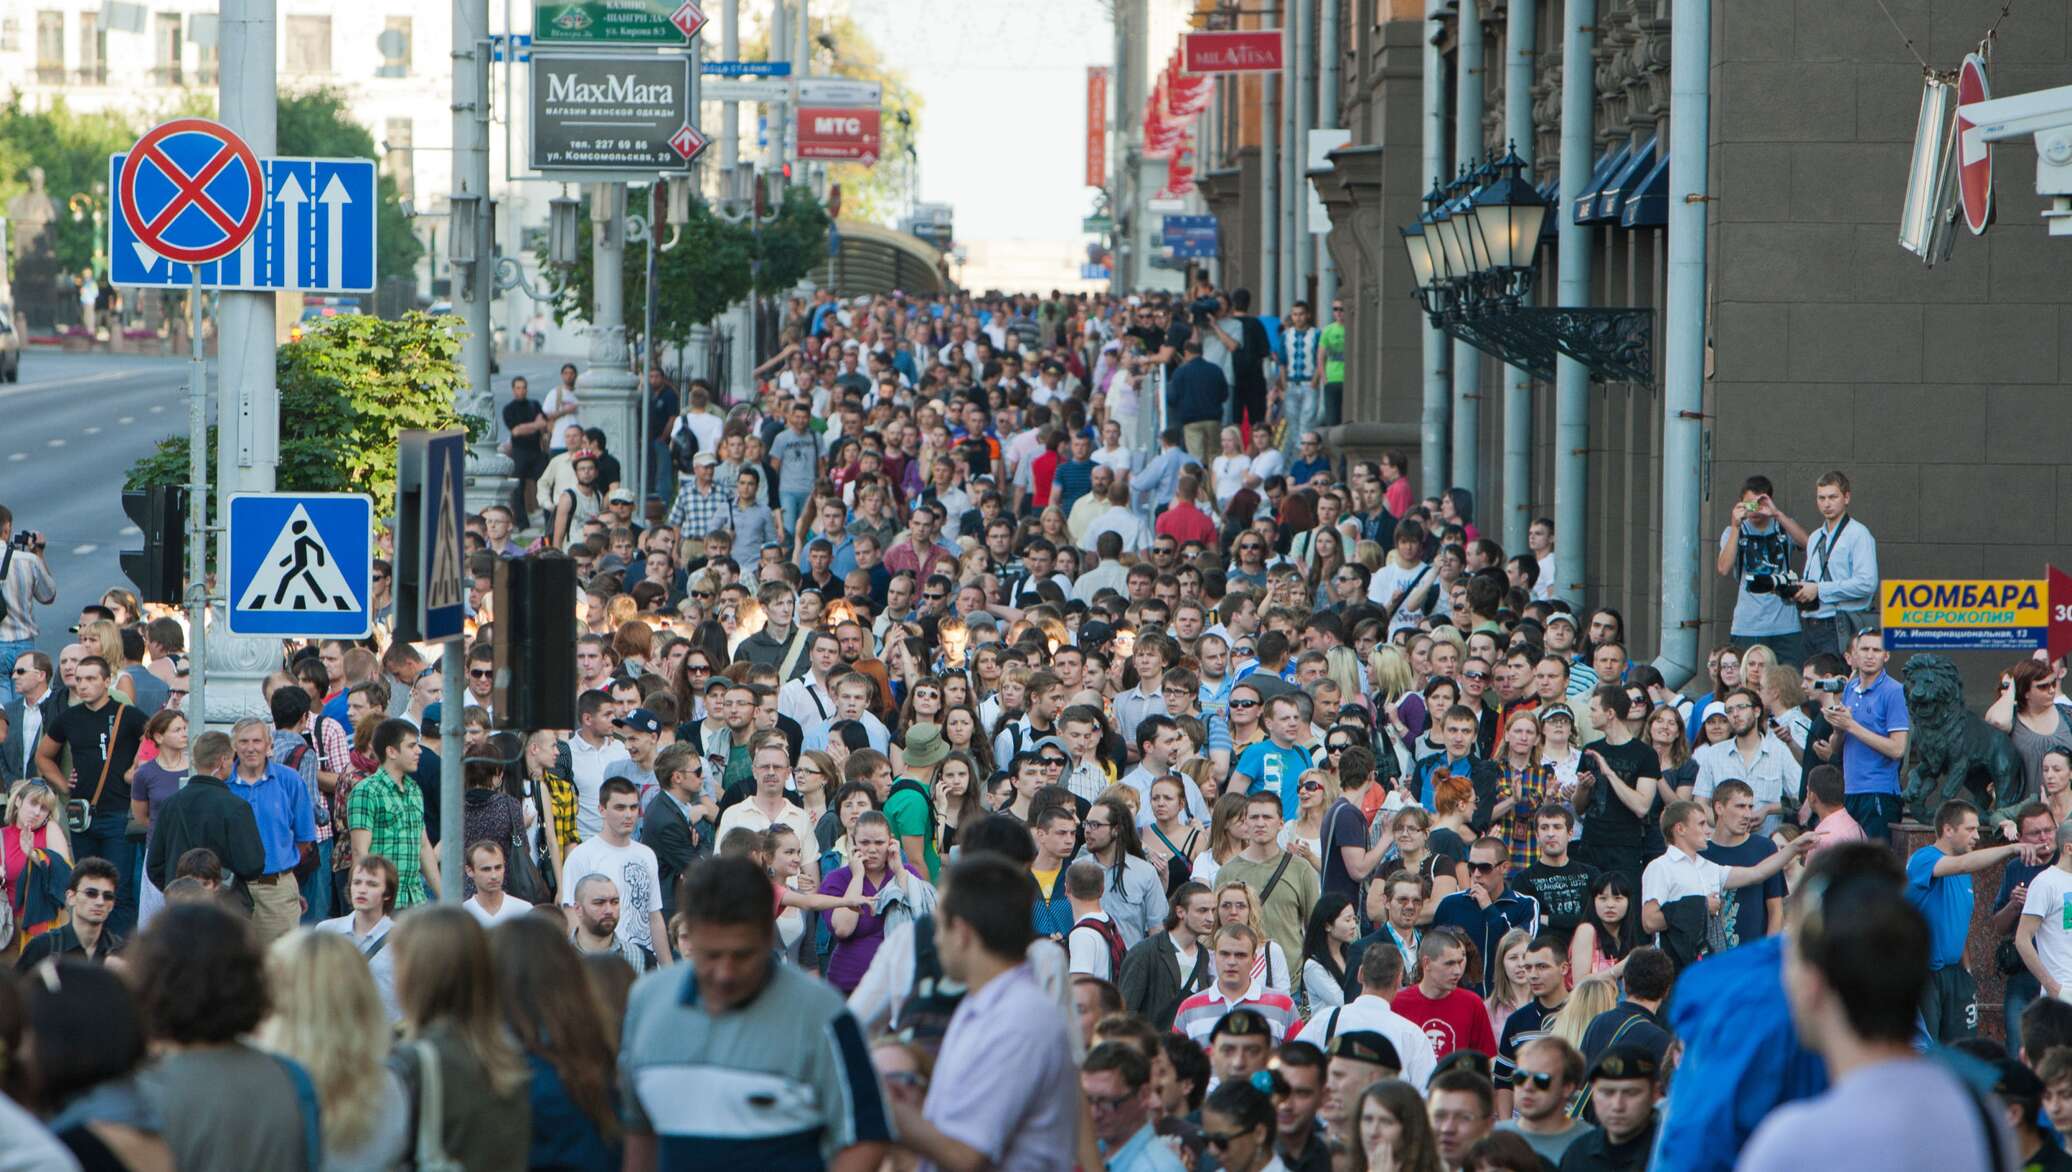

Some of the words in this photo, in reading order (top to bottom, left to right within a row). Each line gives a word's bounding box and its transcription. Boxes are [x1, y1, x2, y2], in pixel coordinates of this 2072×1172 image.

[546, 73, 673, 104] MaxMara
[545, 107, 587, 116] МАГАЗИН
[590, 108, 633, 117] ЖЕНСКОЙ
[636, 108, 675, 118] ОДЕЖДЫ
[815, 117, 861, 135] МТС
[570, 140, 591, 149] тел.
[595, 139, 614, 150] 227
[546, 151, 562, 162] ул.
[565, 150, 655, 162] Комсомольская,
[658, 152, 671, 162] 29
[1888, 585, 2040, 610] ЛОМБАРД
[1902, 610, 2015, 624] КСЕРОКОПИЯ
[1894, 629, 1907, 638] Ул.
[1911, 629, 2014, 639] Интернациональная,
